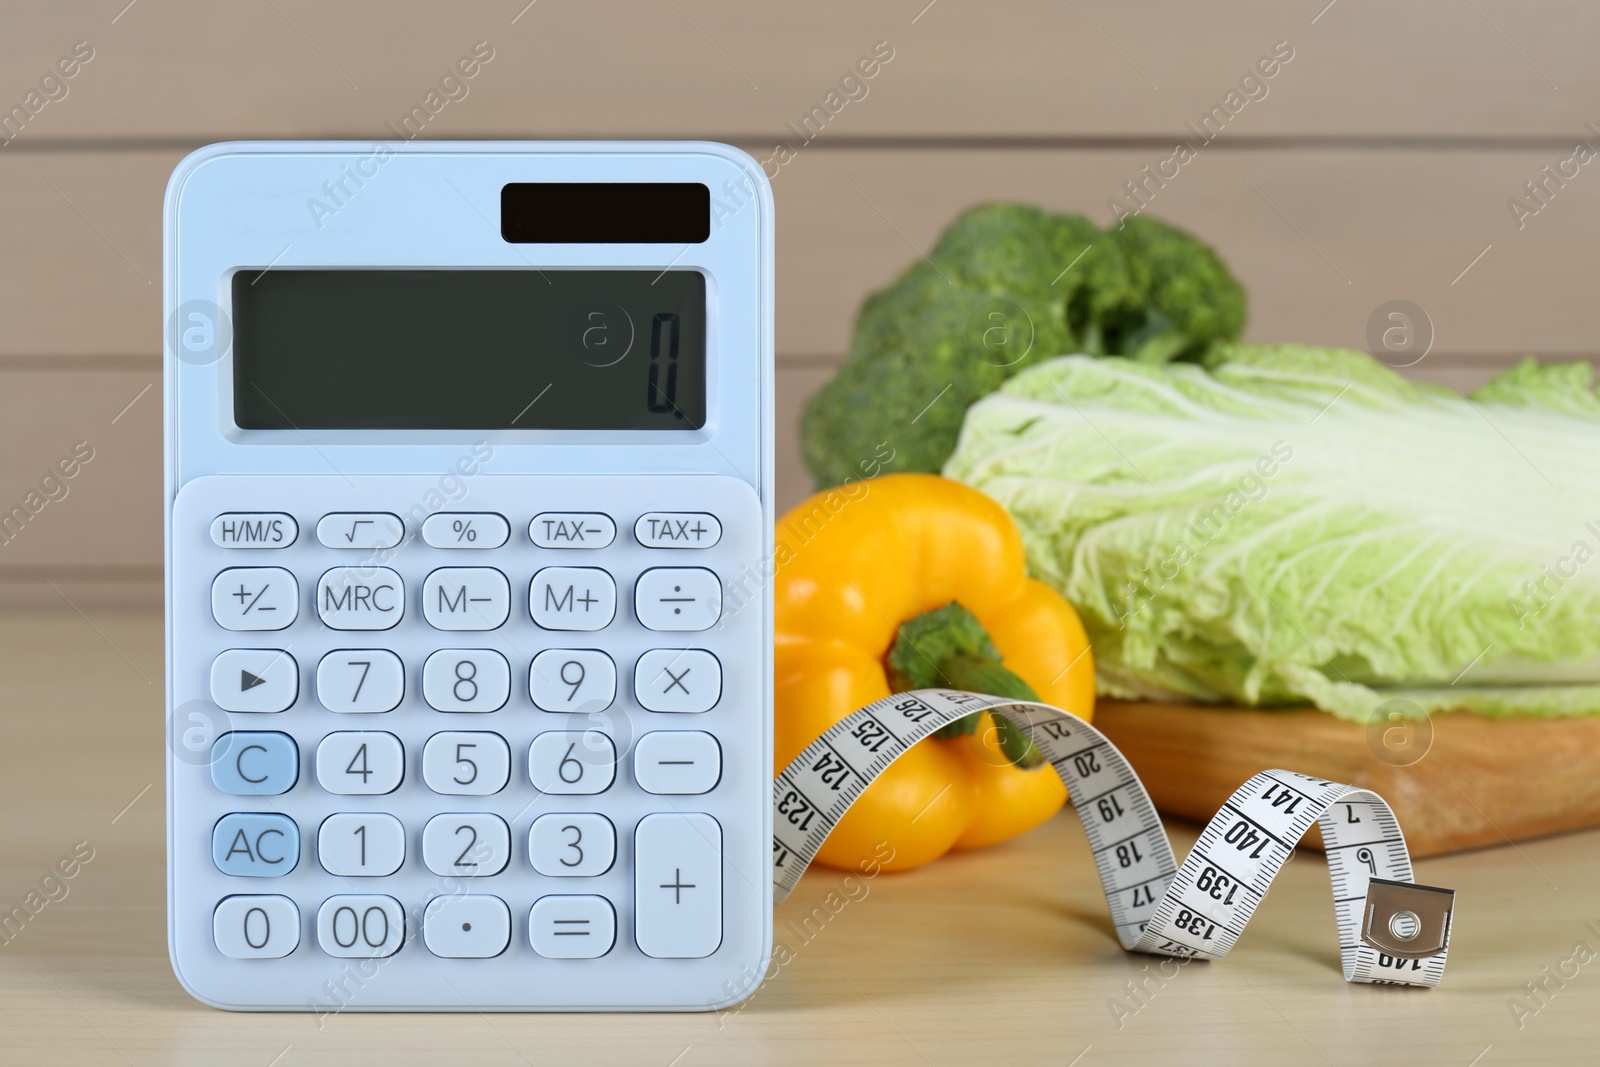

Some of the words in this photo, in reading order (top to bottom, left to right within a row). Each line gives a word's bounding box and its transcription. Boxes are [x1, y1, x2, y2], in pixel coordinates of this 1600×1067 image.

[222, 519, 283, 543] H/M/S
[452, 519, 477, 542] %
[646, 519, 708, 541] TAX+
[325, 584, 395, 613] MRC
[545, 583, 599, 613] M+
[347, 661, 371, 703] 7
[452, 659, 479, 703] 8
[559, 660, 586, 702] 9
[895, 699, 929, 723] 126
[851, 719, 890, 753] 125
[1041, 722, 1071, 741] 21
[236, 744, 269, 784] C
[345, 742, 374, 784] 4
[452, 743, 478, 786] 5
[558, 742, 584, 785] 6
[812, 751, 851, 791] 124
[1073, 751, 1101, 778] 20
[777, 790, 816, 832] 123
[1097, 795, 1125, 823] 19
[1262, 783, 1304, 815] 141
[1345, 804, 1361, 824] 7
[224, 828, 285, 865] AC
[353, 825, 366, 867] 1
[453, 824, 478, 867] 2
[559, 824, 584, 868] 3
[1116, 840, 1143, 869] 18
[1224, 820, 1271, 860] 140
[1132, 884, 1156, 908] 17
[1196, 866, 1239, 906] 139
[243, 907, 271, 950] 0
[332, 905, 389, 949] 00
[1174, 909, 1216, 940] 138
